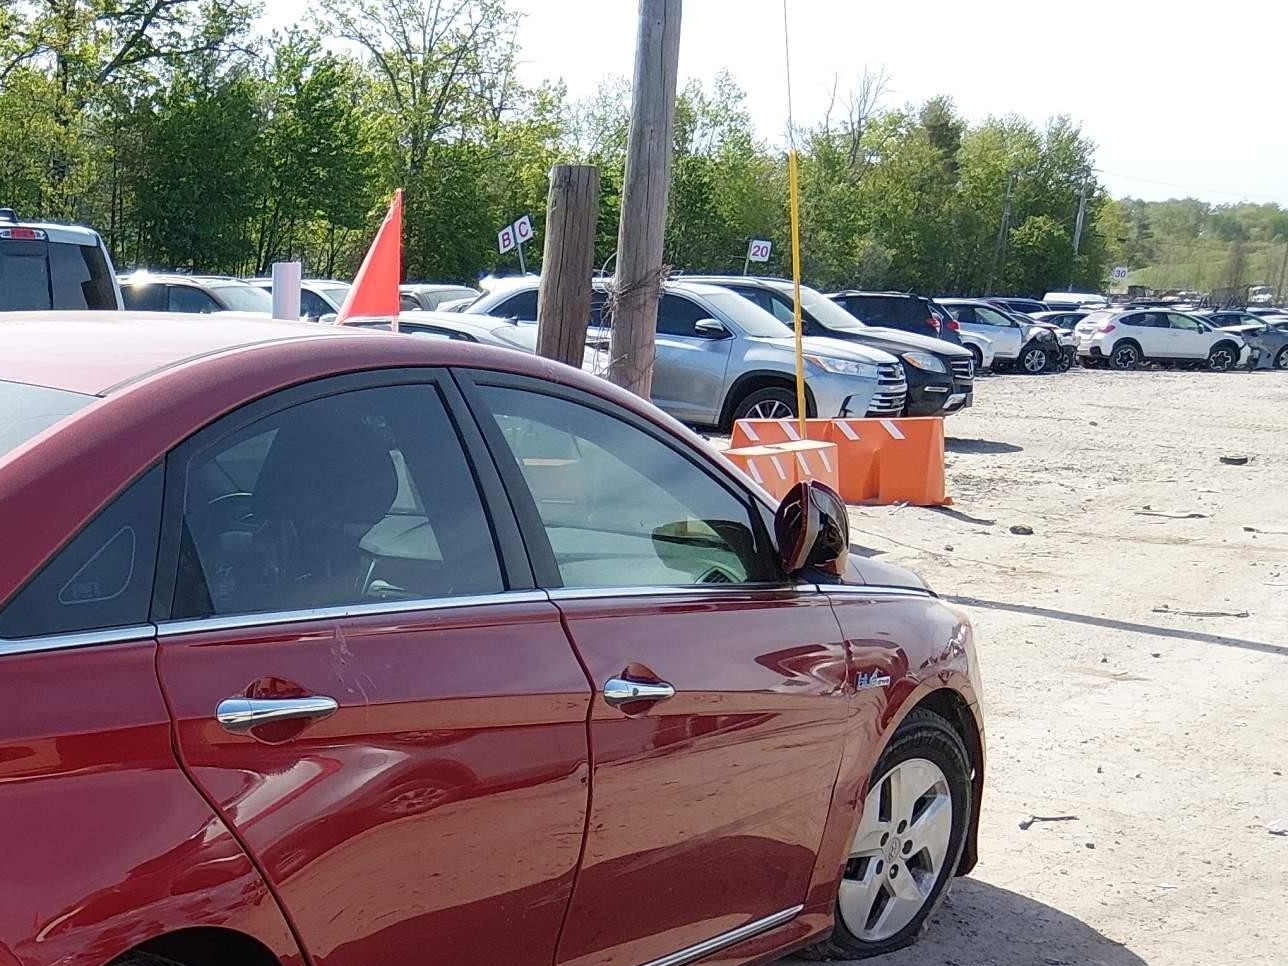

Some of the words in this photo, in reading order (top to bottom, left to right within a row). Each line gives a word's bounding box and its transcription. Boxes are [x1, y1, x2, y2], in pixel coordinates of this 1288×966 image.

[502, 232, 511, 248] B
[518, 221, 529, 237] C
[752, 245, 769, 257] 20
[1114, 270, 1126, 278] 30
